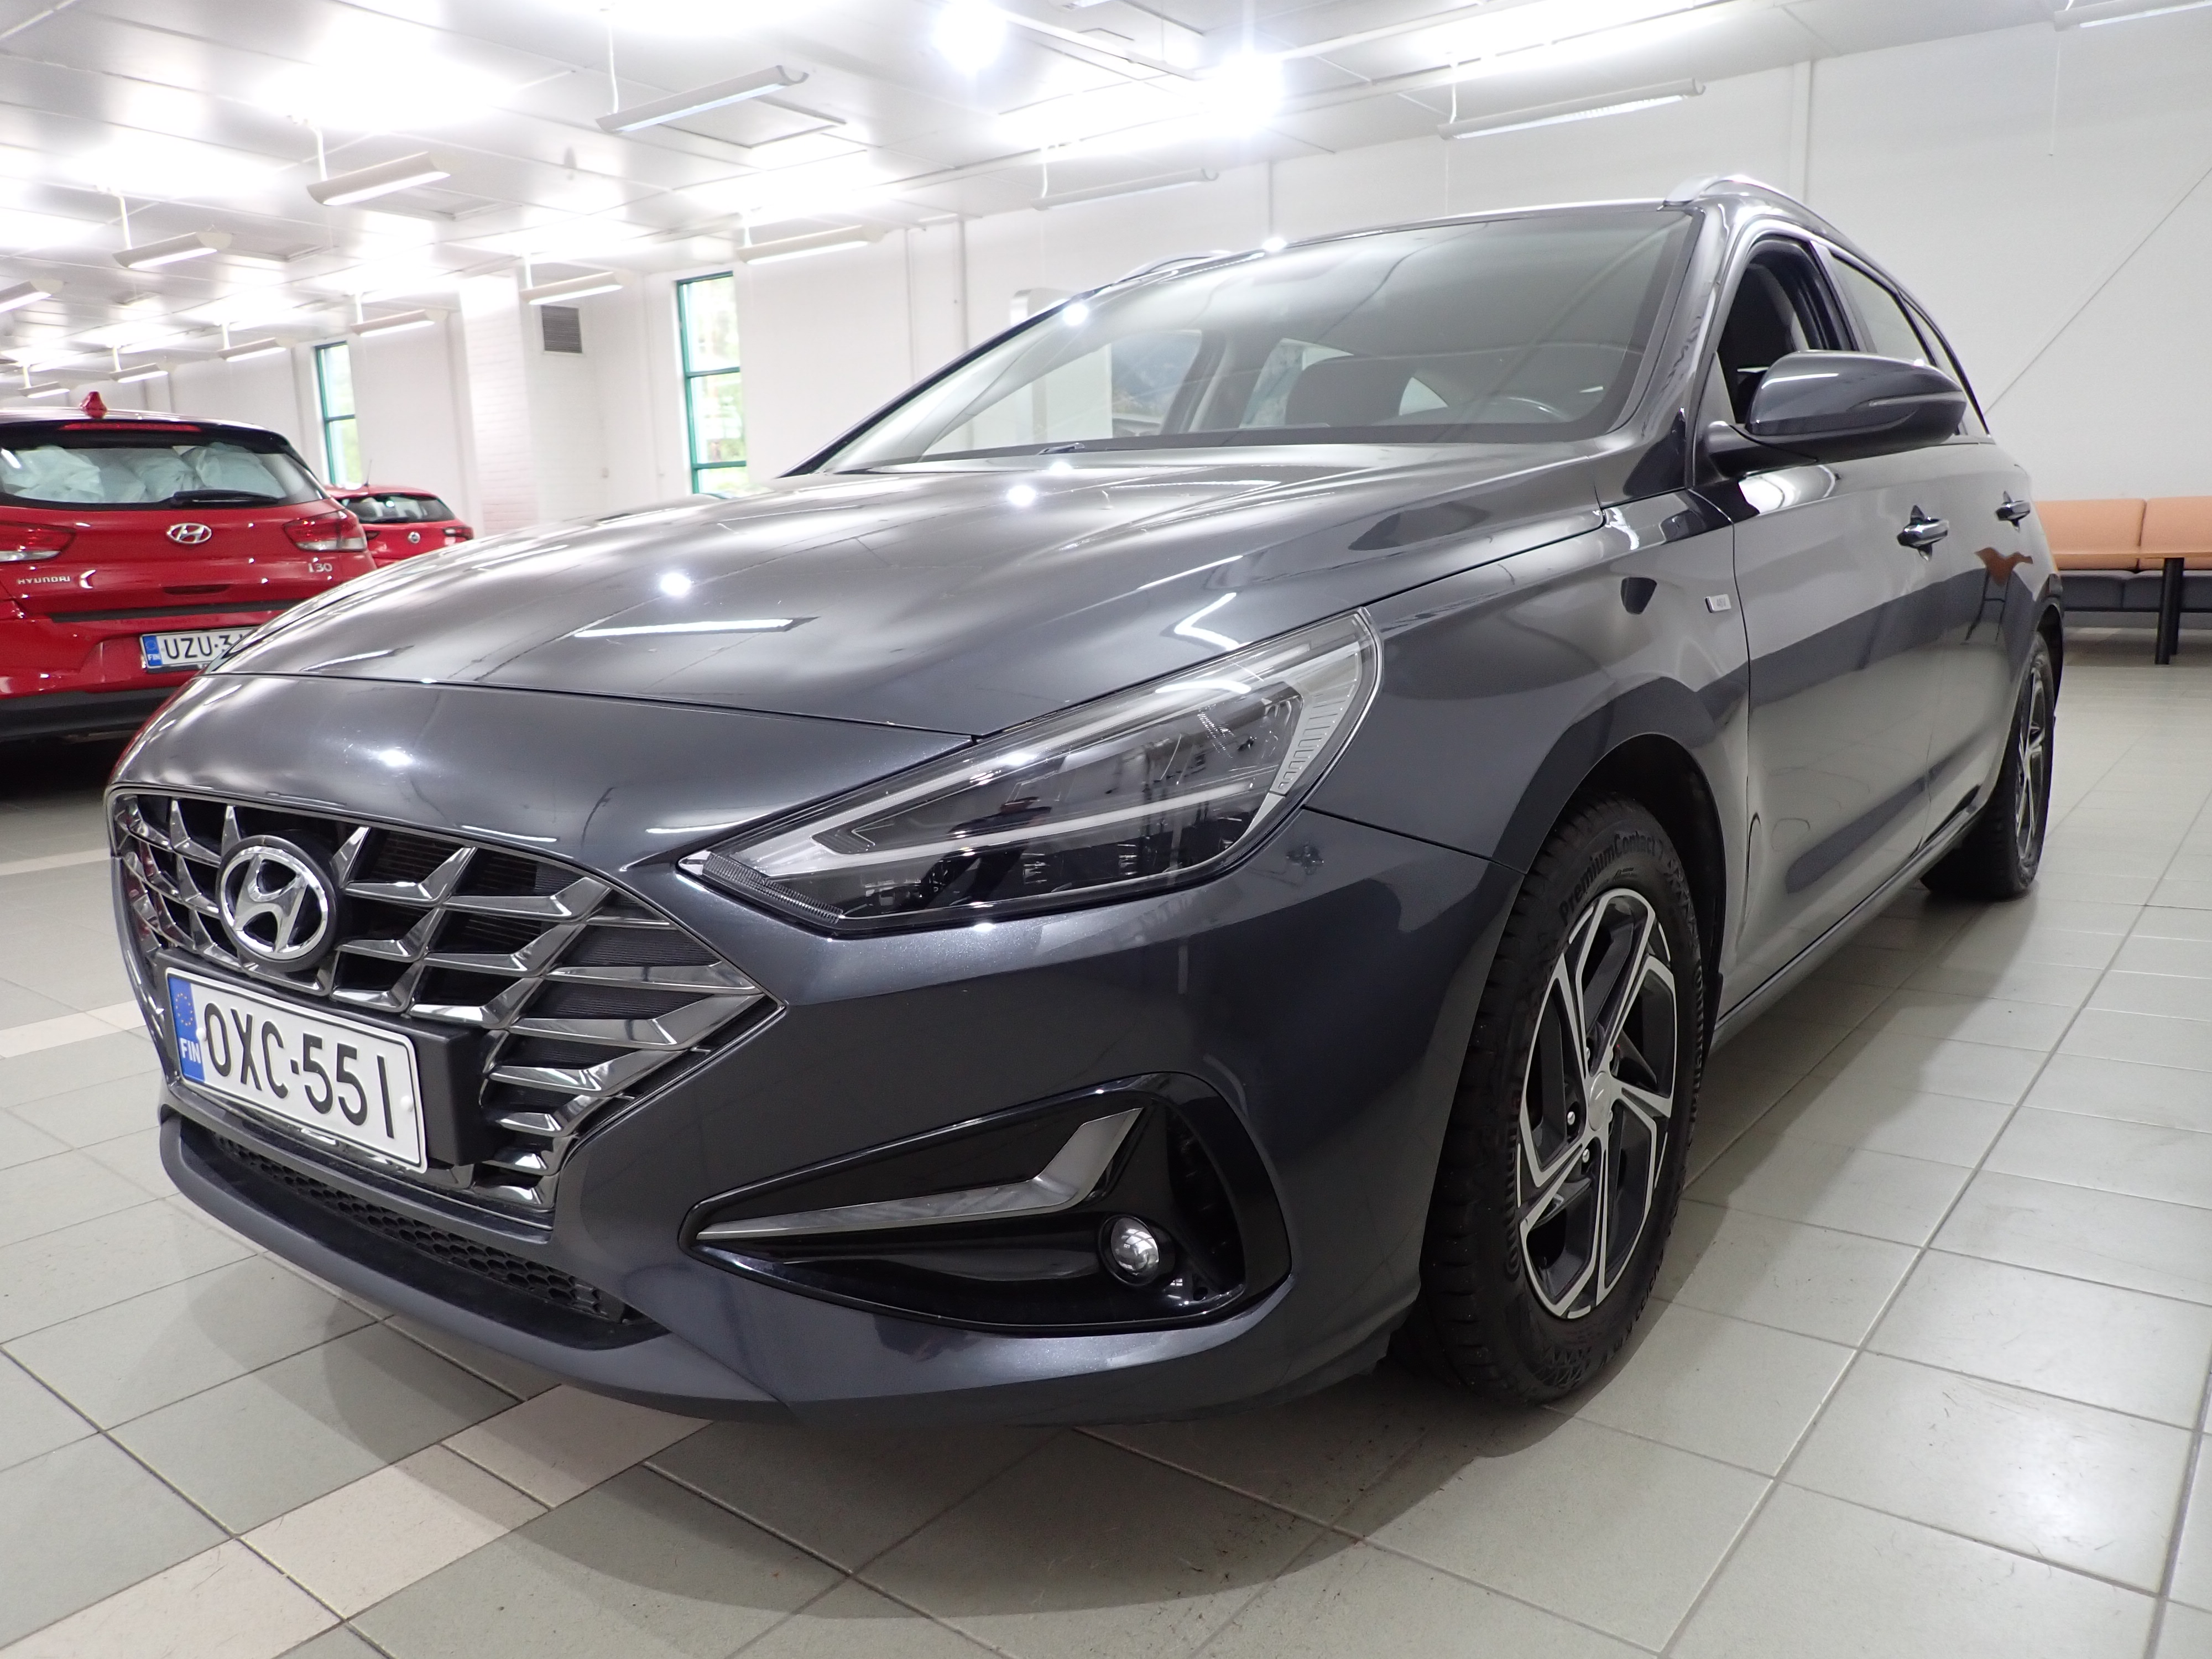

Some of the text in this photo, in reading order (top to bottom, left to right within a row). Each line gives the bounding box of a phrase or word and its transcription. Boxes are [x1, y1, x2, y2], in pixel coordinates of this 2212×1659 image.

[164, 634, 243, 659] UZU-3
[179, 1037, 201, 1064] FIN
[204, 1003, 394, 1139] OXC-551
